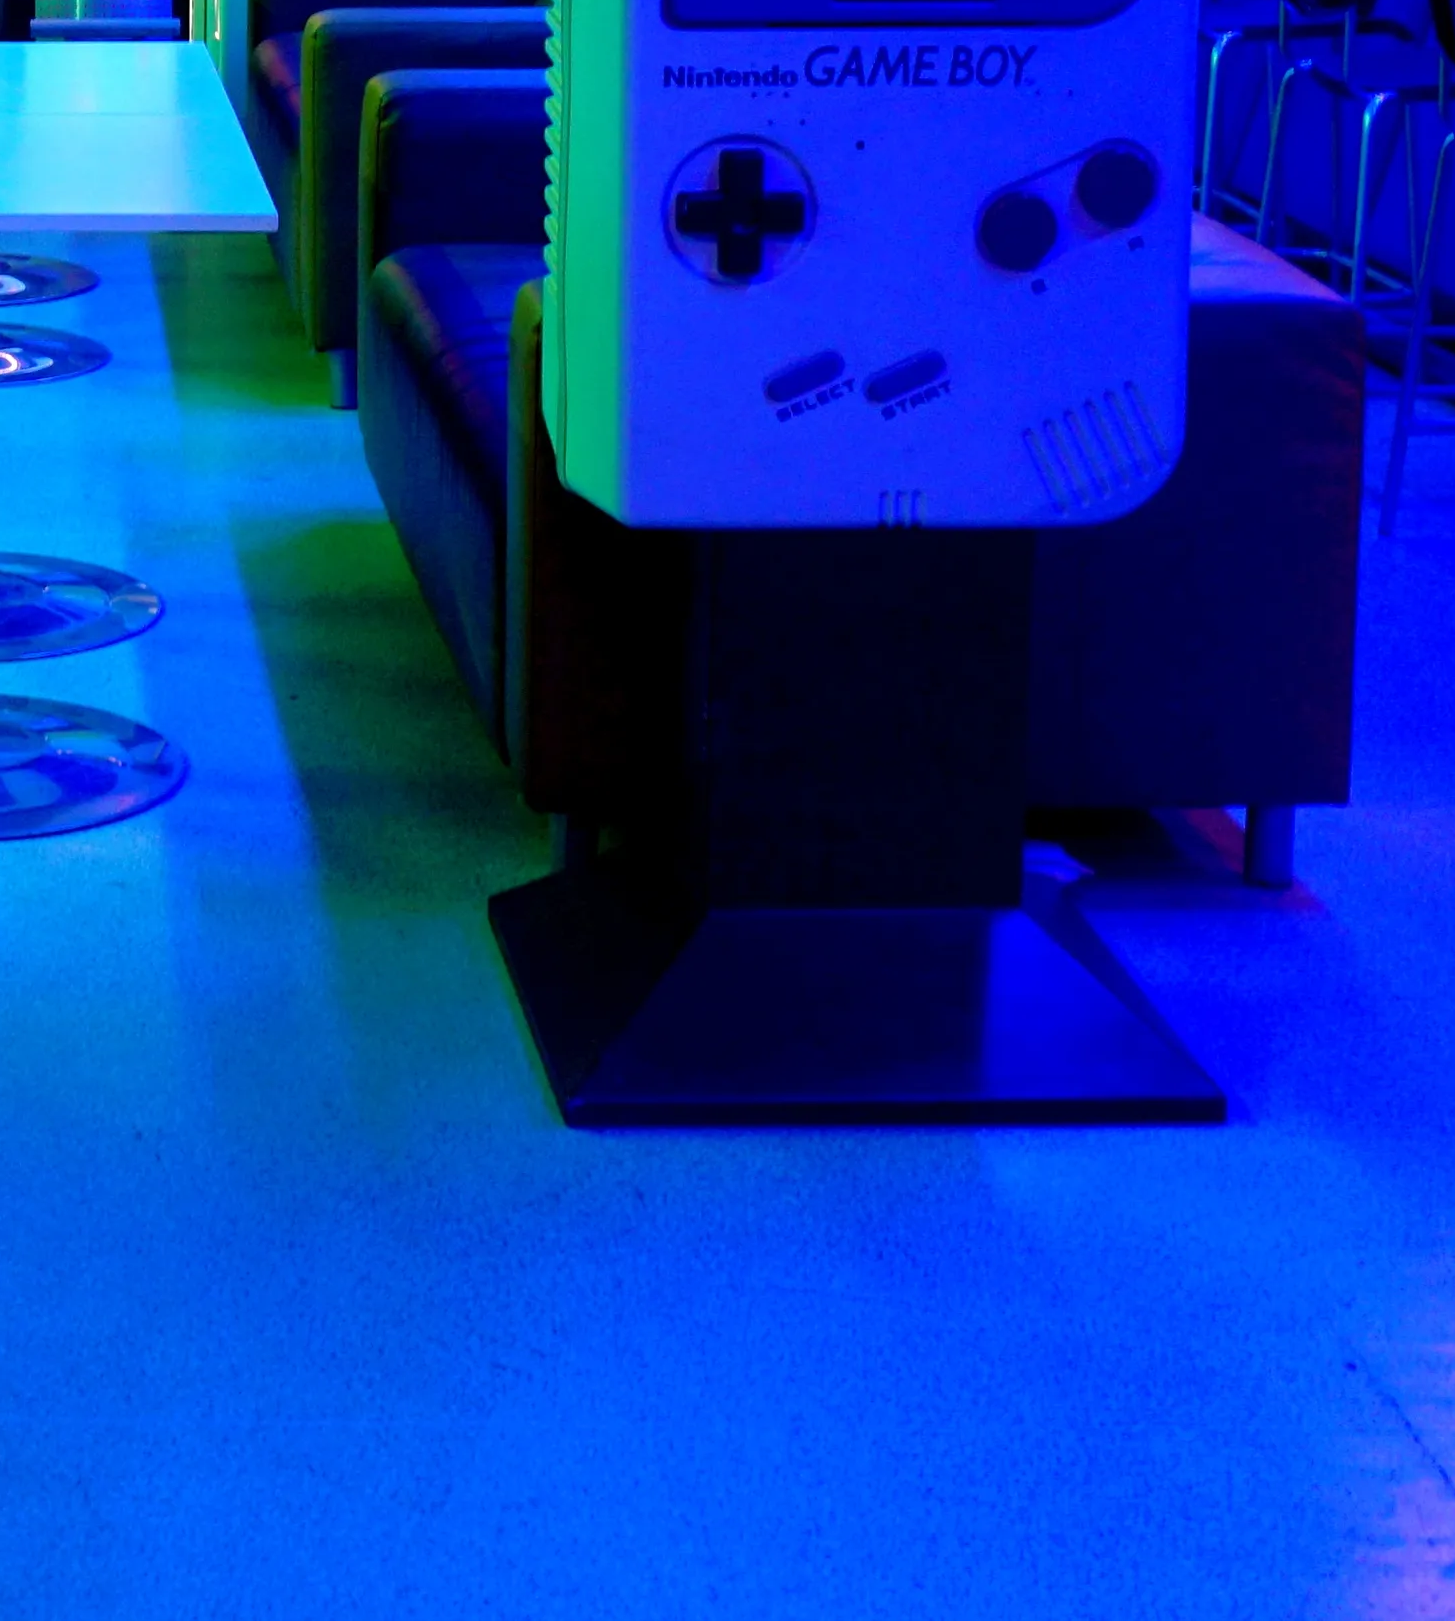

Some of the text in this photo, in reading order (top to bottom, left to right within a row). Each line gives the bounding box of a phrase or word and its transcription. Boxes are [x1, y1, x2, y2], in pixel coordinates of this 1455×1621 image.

[663, 44, 1038, 89] Nintendo GAME BOY
[775, 378, 952, 424] SELECT START
